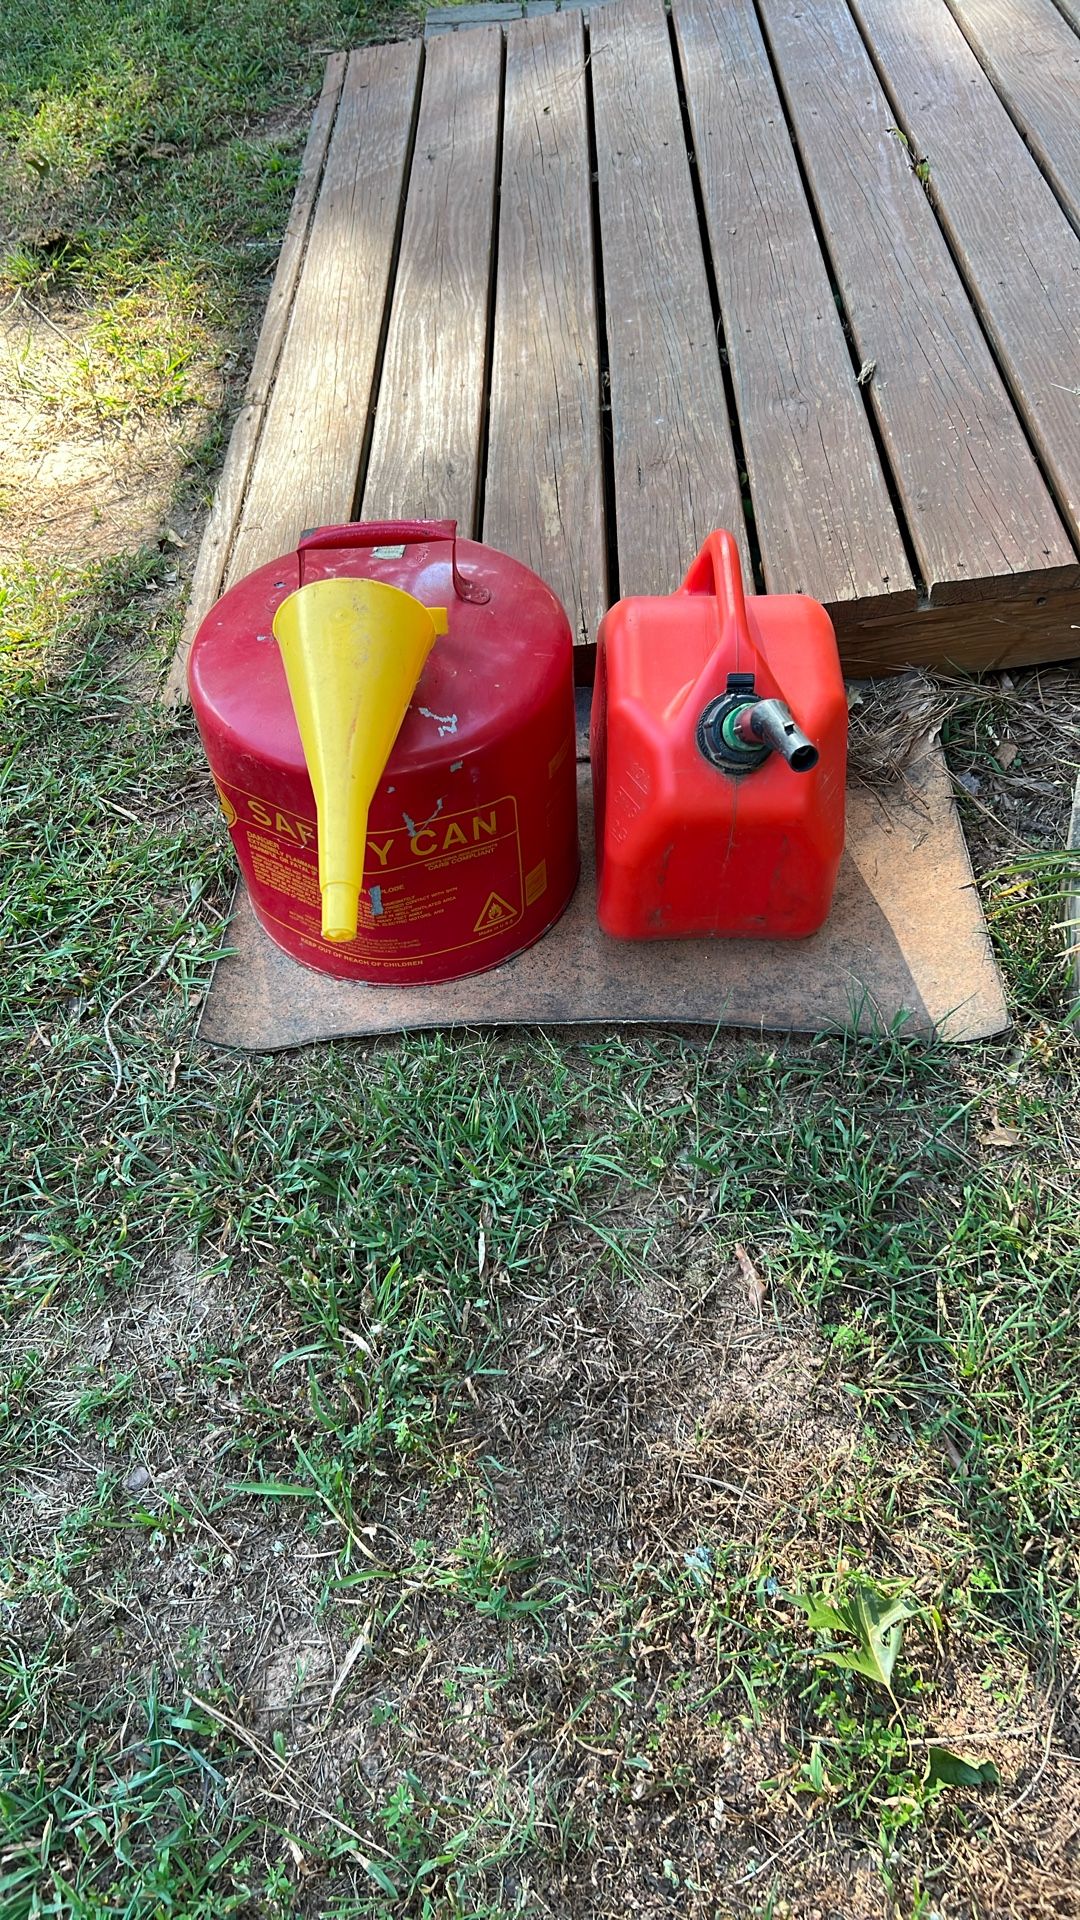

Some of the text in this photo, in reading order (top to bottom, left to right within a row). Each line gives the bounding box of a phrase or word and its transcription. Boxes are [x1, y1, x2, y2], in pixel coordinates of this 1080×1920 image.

[246, 830, 279, 849] DANGER
[410, 811, 497, 856] CAN
[451, 846, 496, 864] COMPLIANT
[300, 937, 317, 948] KEEP
[318, 945, 332, 955] OUT
[333, 951, 343, 959] OF
[344, 955, 370, 966] REACH
[384, 959, 424, 968] CHILDREN
